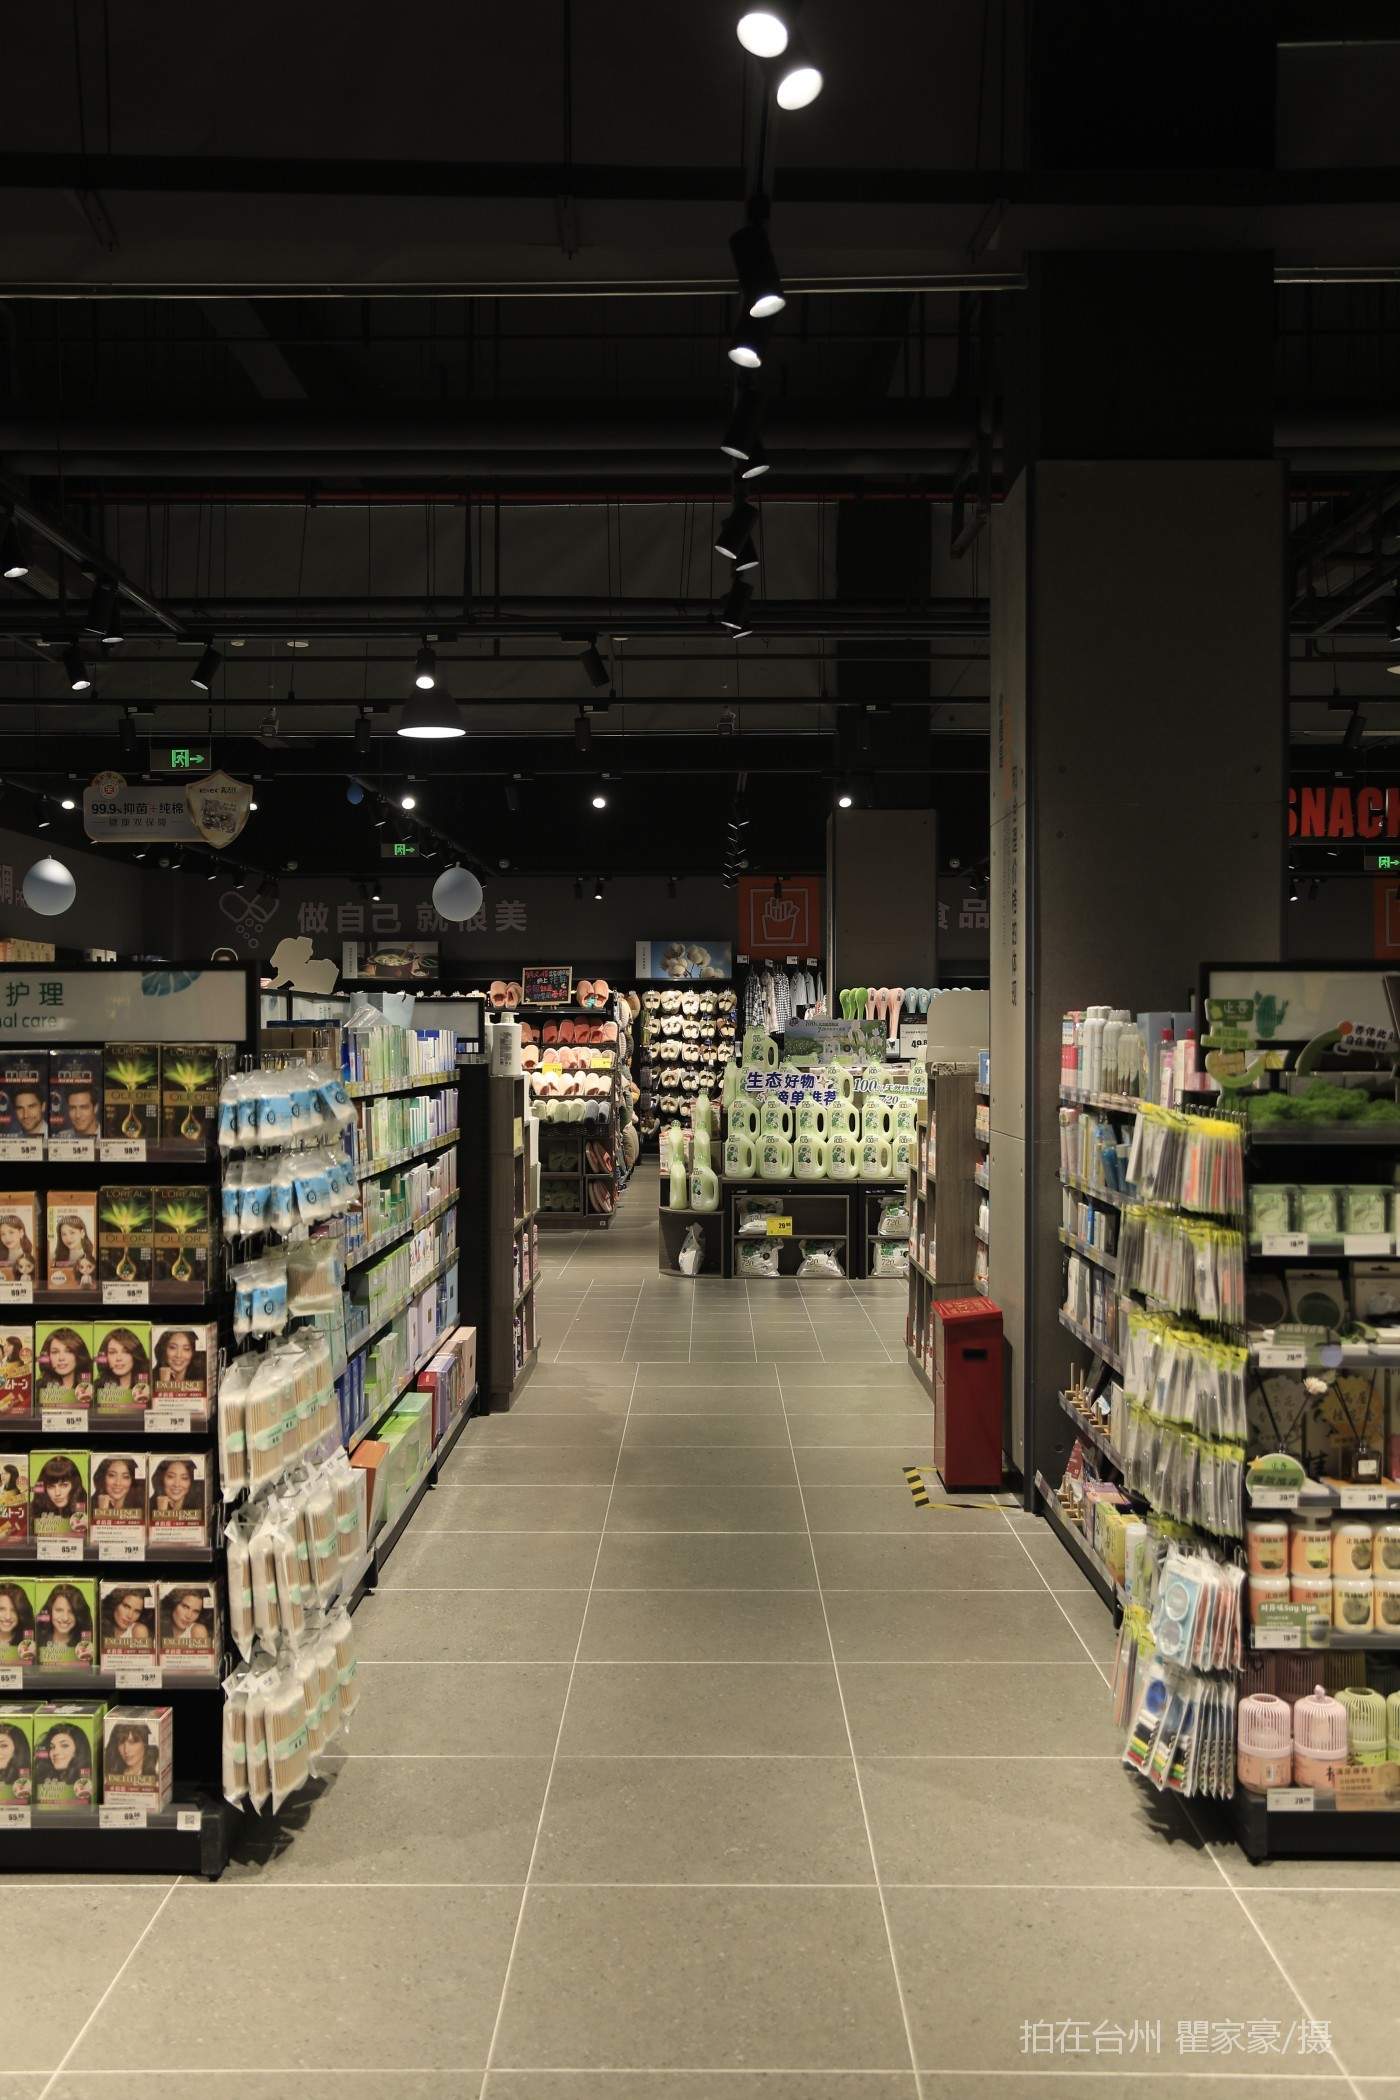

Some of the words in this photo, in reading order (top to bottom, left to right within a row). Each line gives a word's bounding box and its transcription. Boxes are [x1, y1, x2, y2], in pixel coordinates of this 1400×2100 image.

[297, 902, 402, 933] 做自己
[6, 981, 64, 1007] 护理
[22, 1014, 57, 1029] care
[746, 1071, 816, 1089] 生态好物
